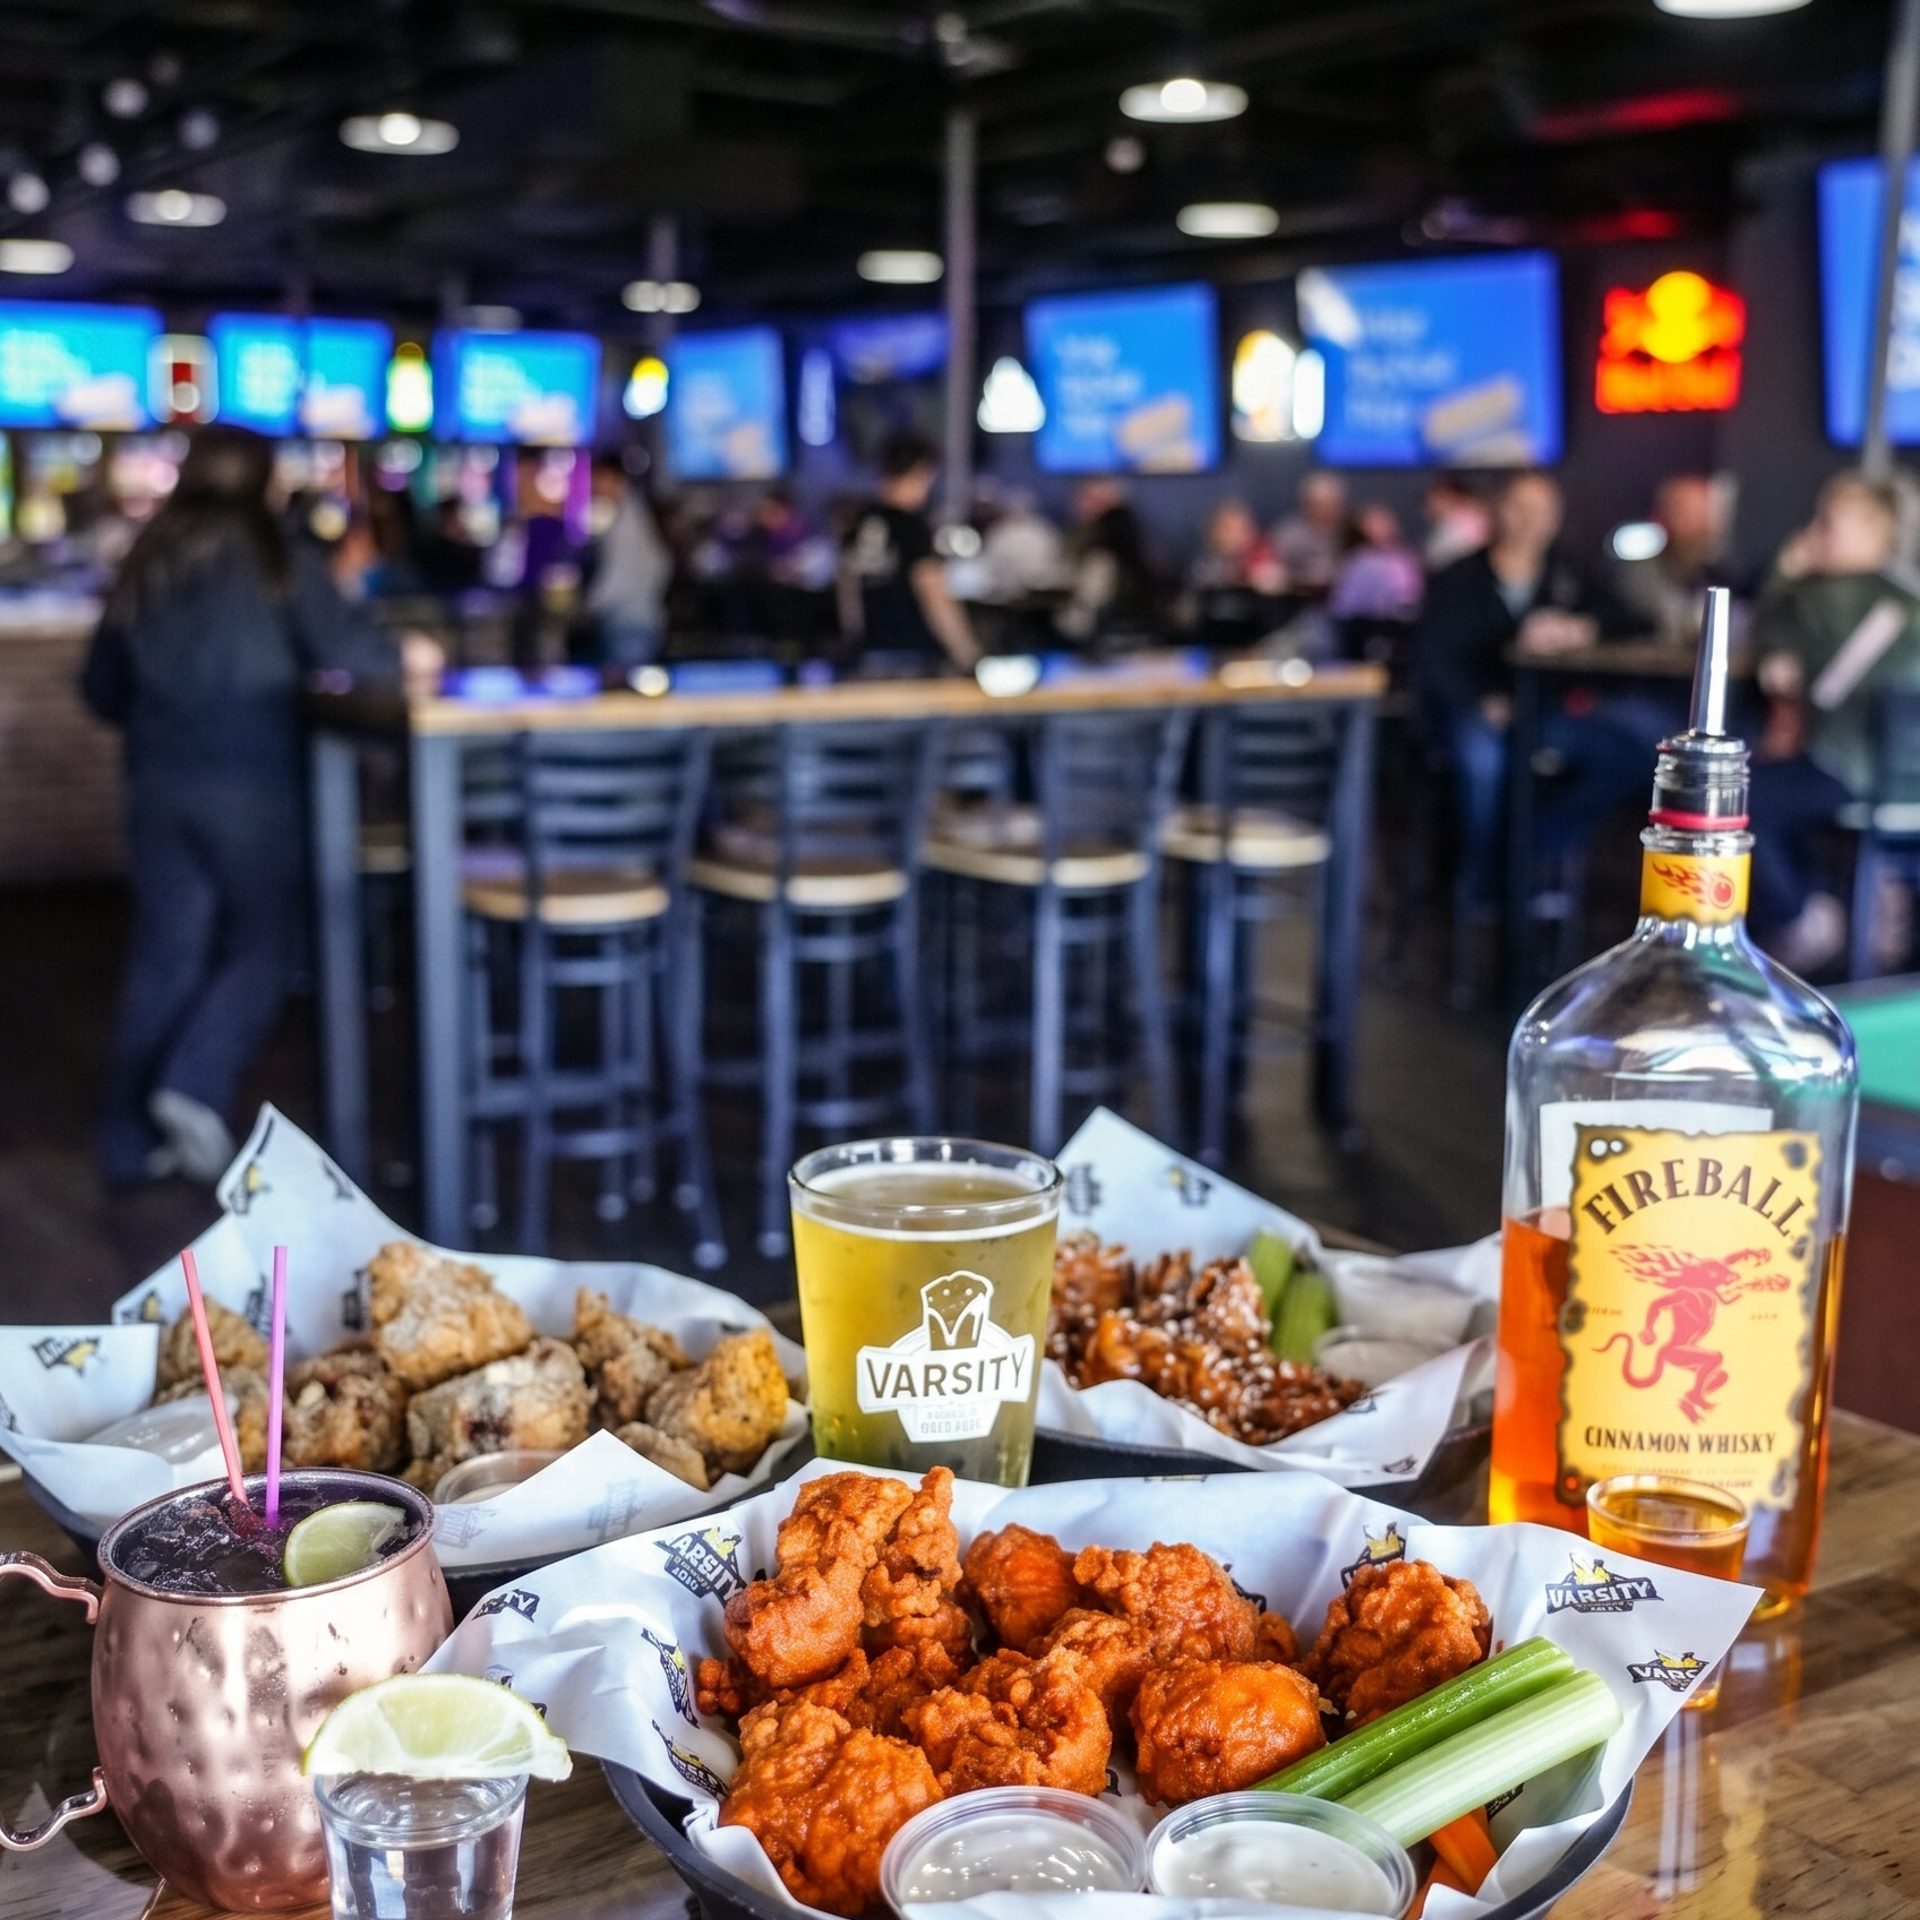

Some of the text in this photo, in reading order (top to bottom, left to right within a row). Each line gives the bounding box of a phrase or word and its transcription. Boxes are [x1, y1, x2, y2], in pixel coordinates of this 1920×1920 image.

[1581, 1157, 1805, 1237] FIREBALL
[866, 1347, 1027, 1399] VARSITY
[1585, 1426, 1776, 1454] CINNAMON WHISKY
[671, 1534, 743, 1601] ARSITY
[1549, 1581, 1648, 1608] VARSITY
